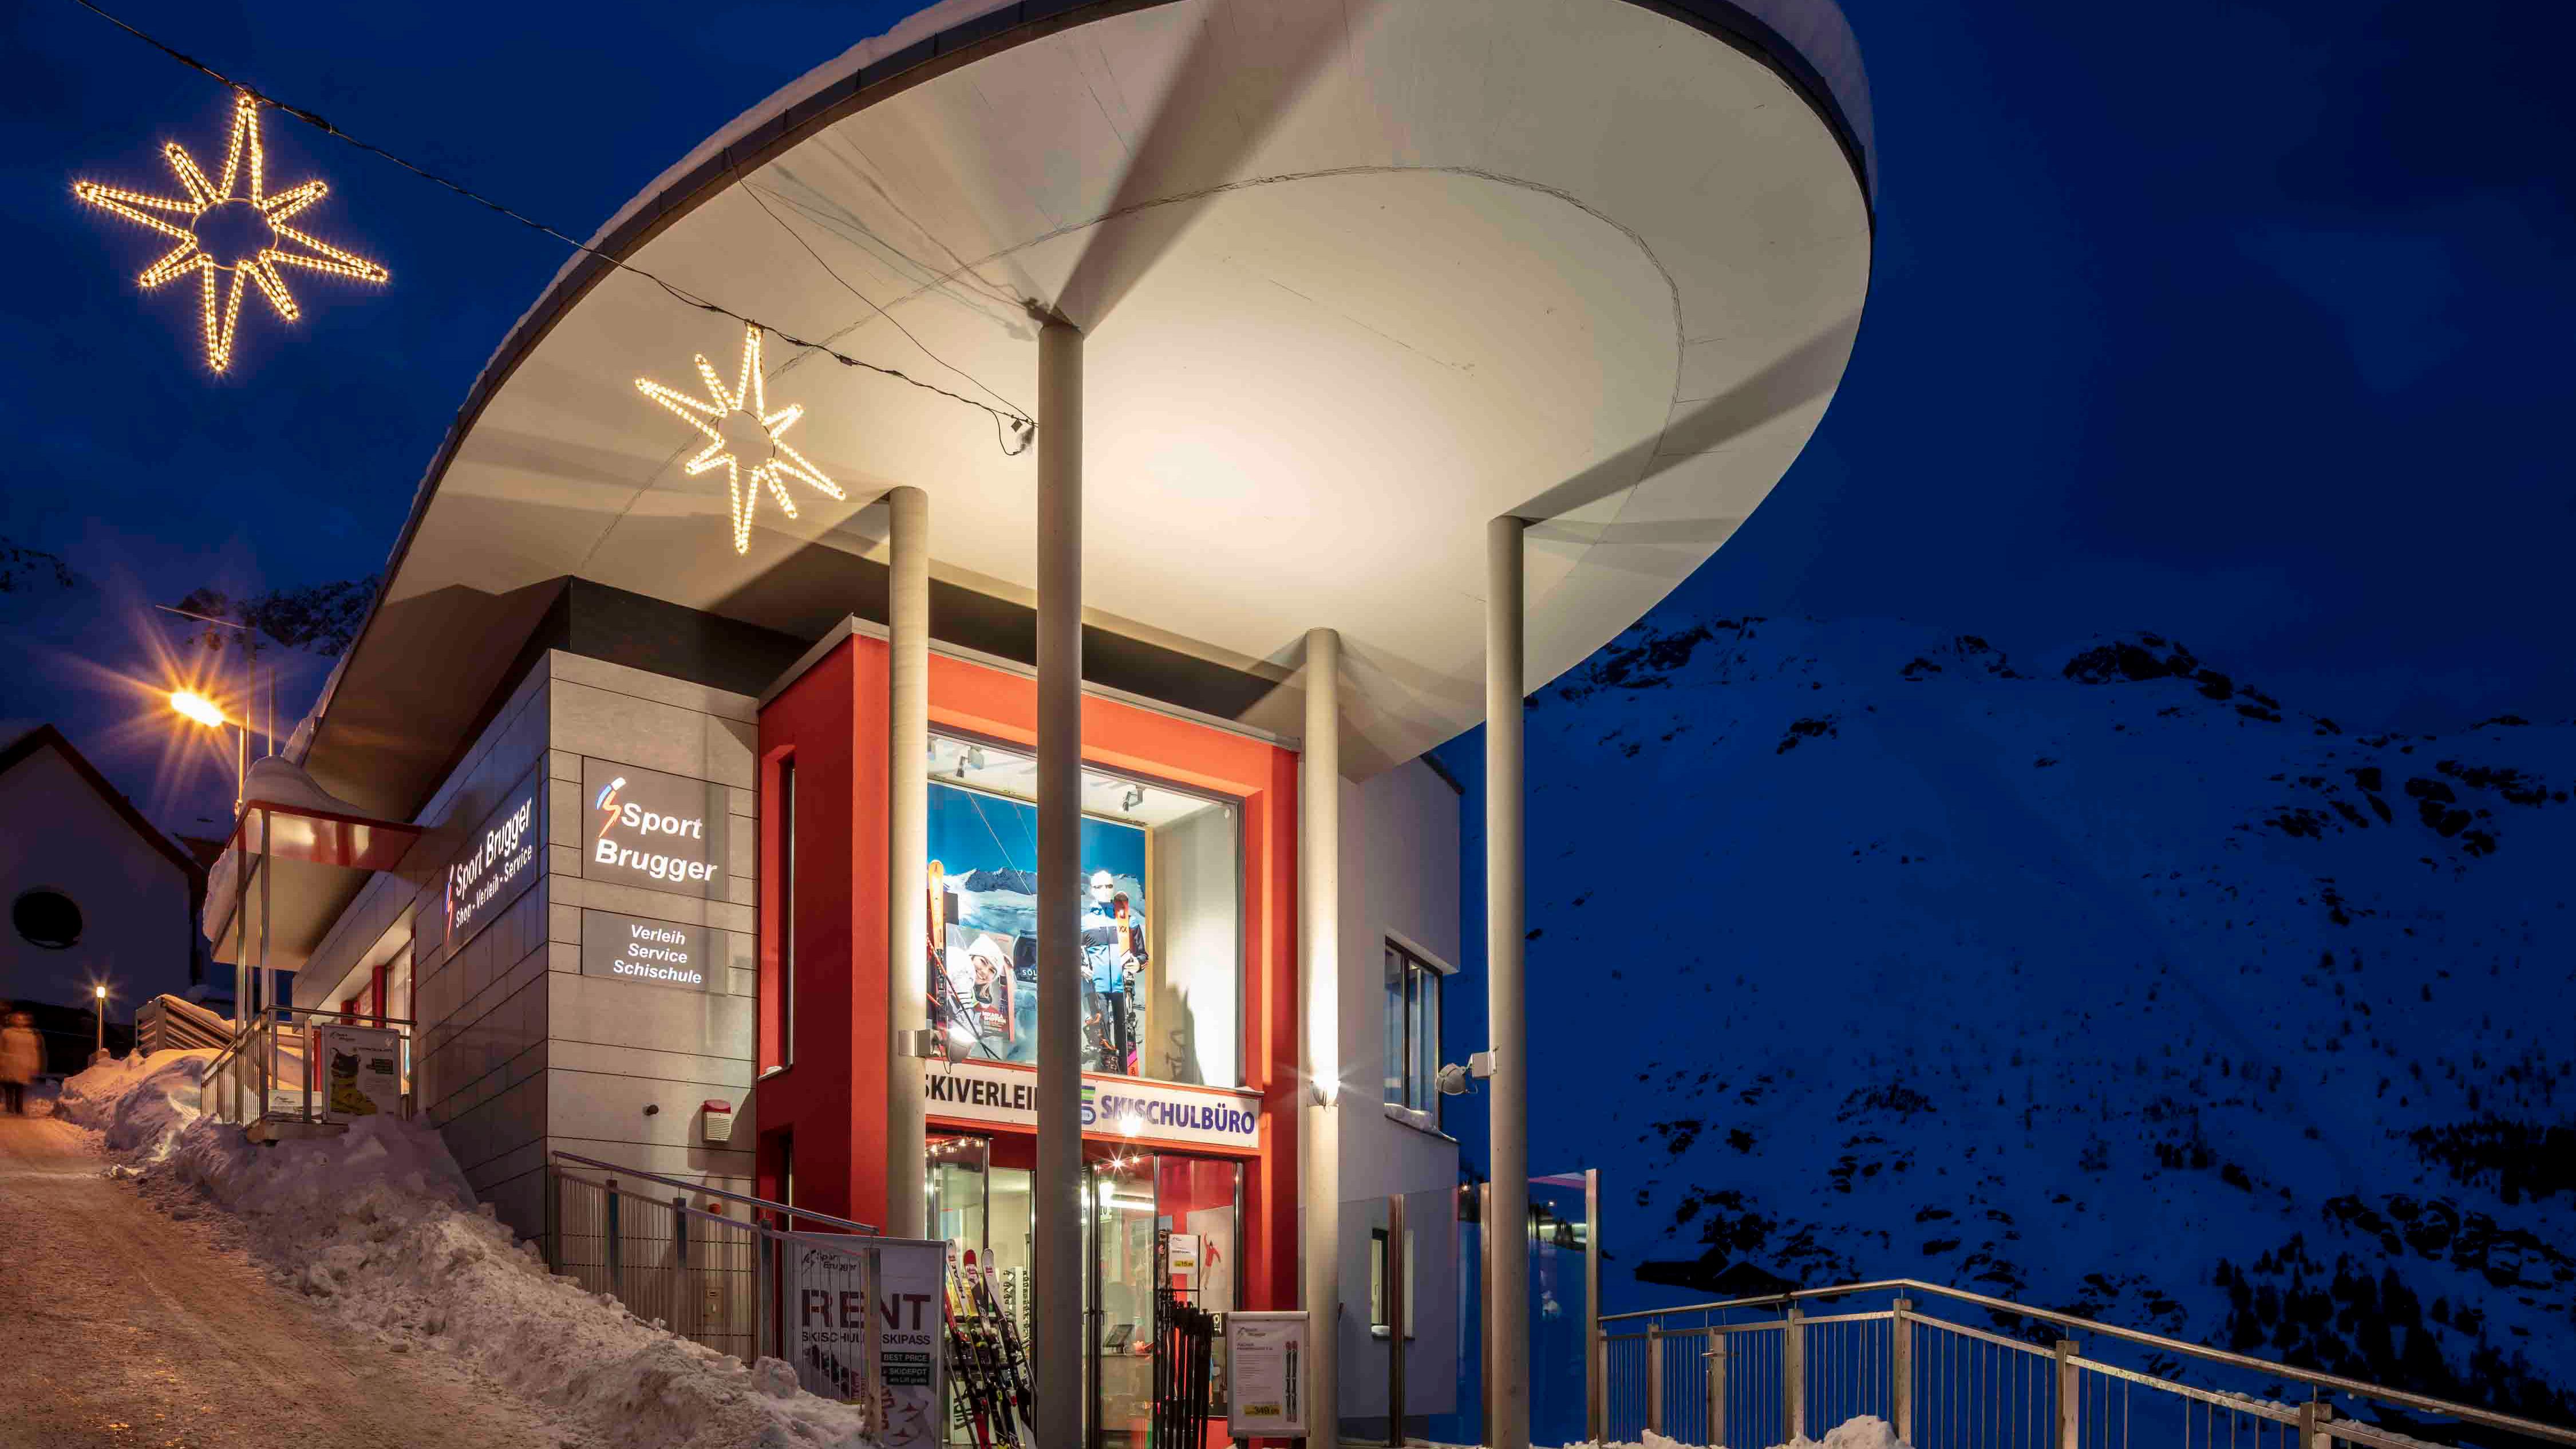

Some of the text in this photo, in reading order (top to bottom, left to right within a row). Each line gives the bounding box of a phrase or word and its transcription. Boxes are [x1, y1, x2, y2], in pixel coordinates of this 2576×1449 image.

[621, 803, 702, 839] Sport
[456, 797, 532, 901] Sport Brugger
[595, 839, 718, 882] Brugger
[456, 904, 471, 928] Shop
[476, 873, 499, 909] Verleih
[504, 844, 532, 882] Service
[628, 943, 688, 963] Service
[631, 924, 686, 945] Verleih
[614, 960, 701, 984] Schischule
[926, 1073, 1255, 1134] KIVERLEI SKISCHULBÜRO
[801, 1289, 931, 1330] RENT
[882, 1333, 930, 1345] SKIPASS
